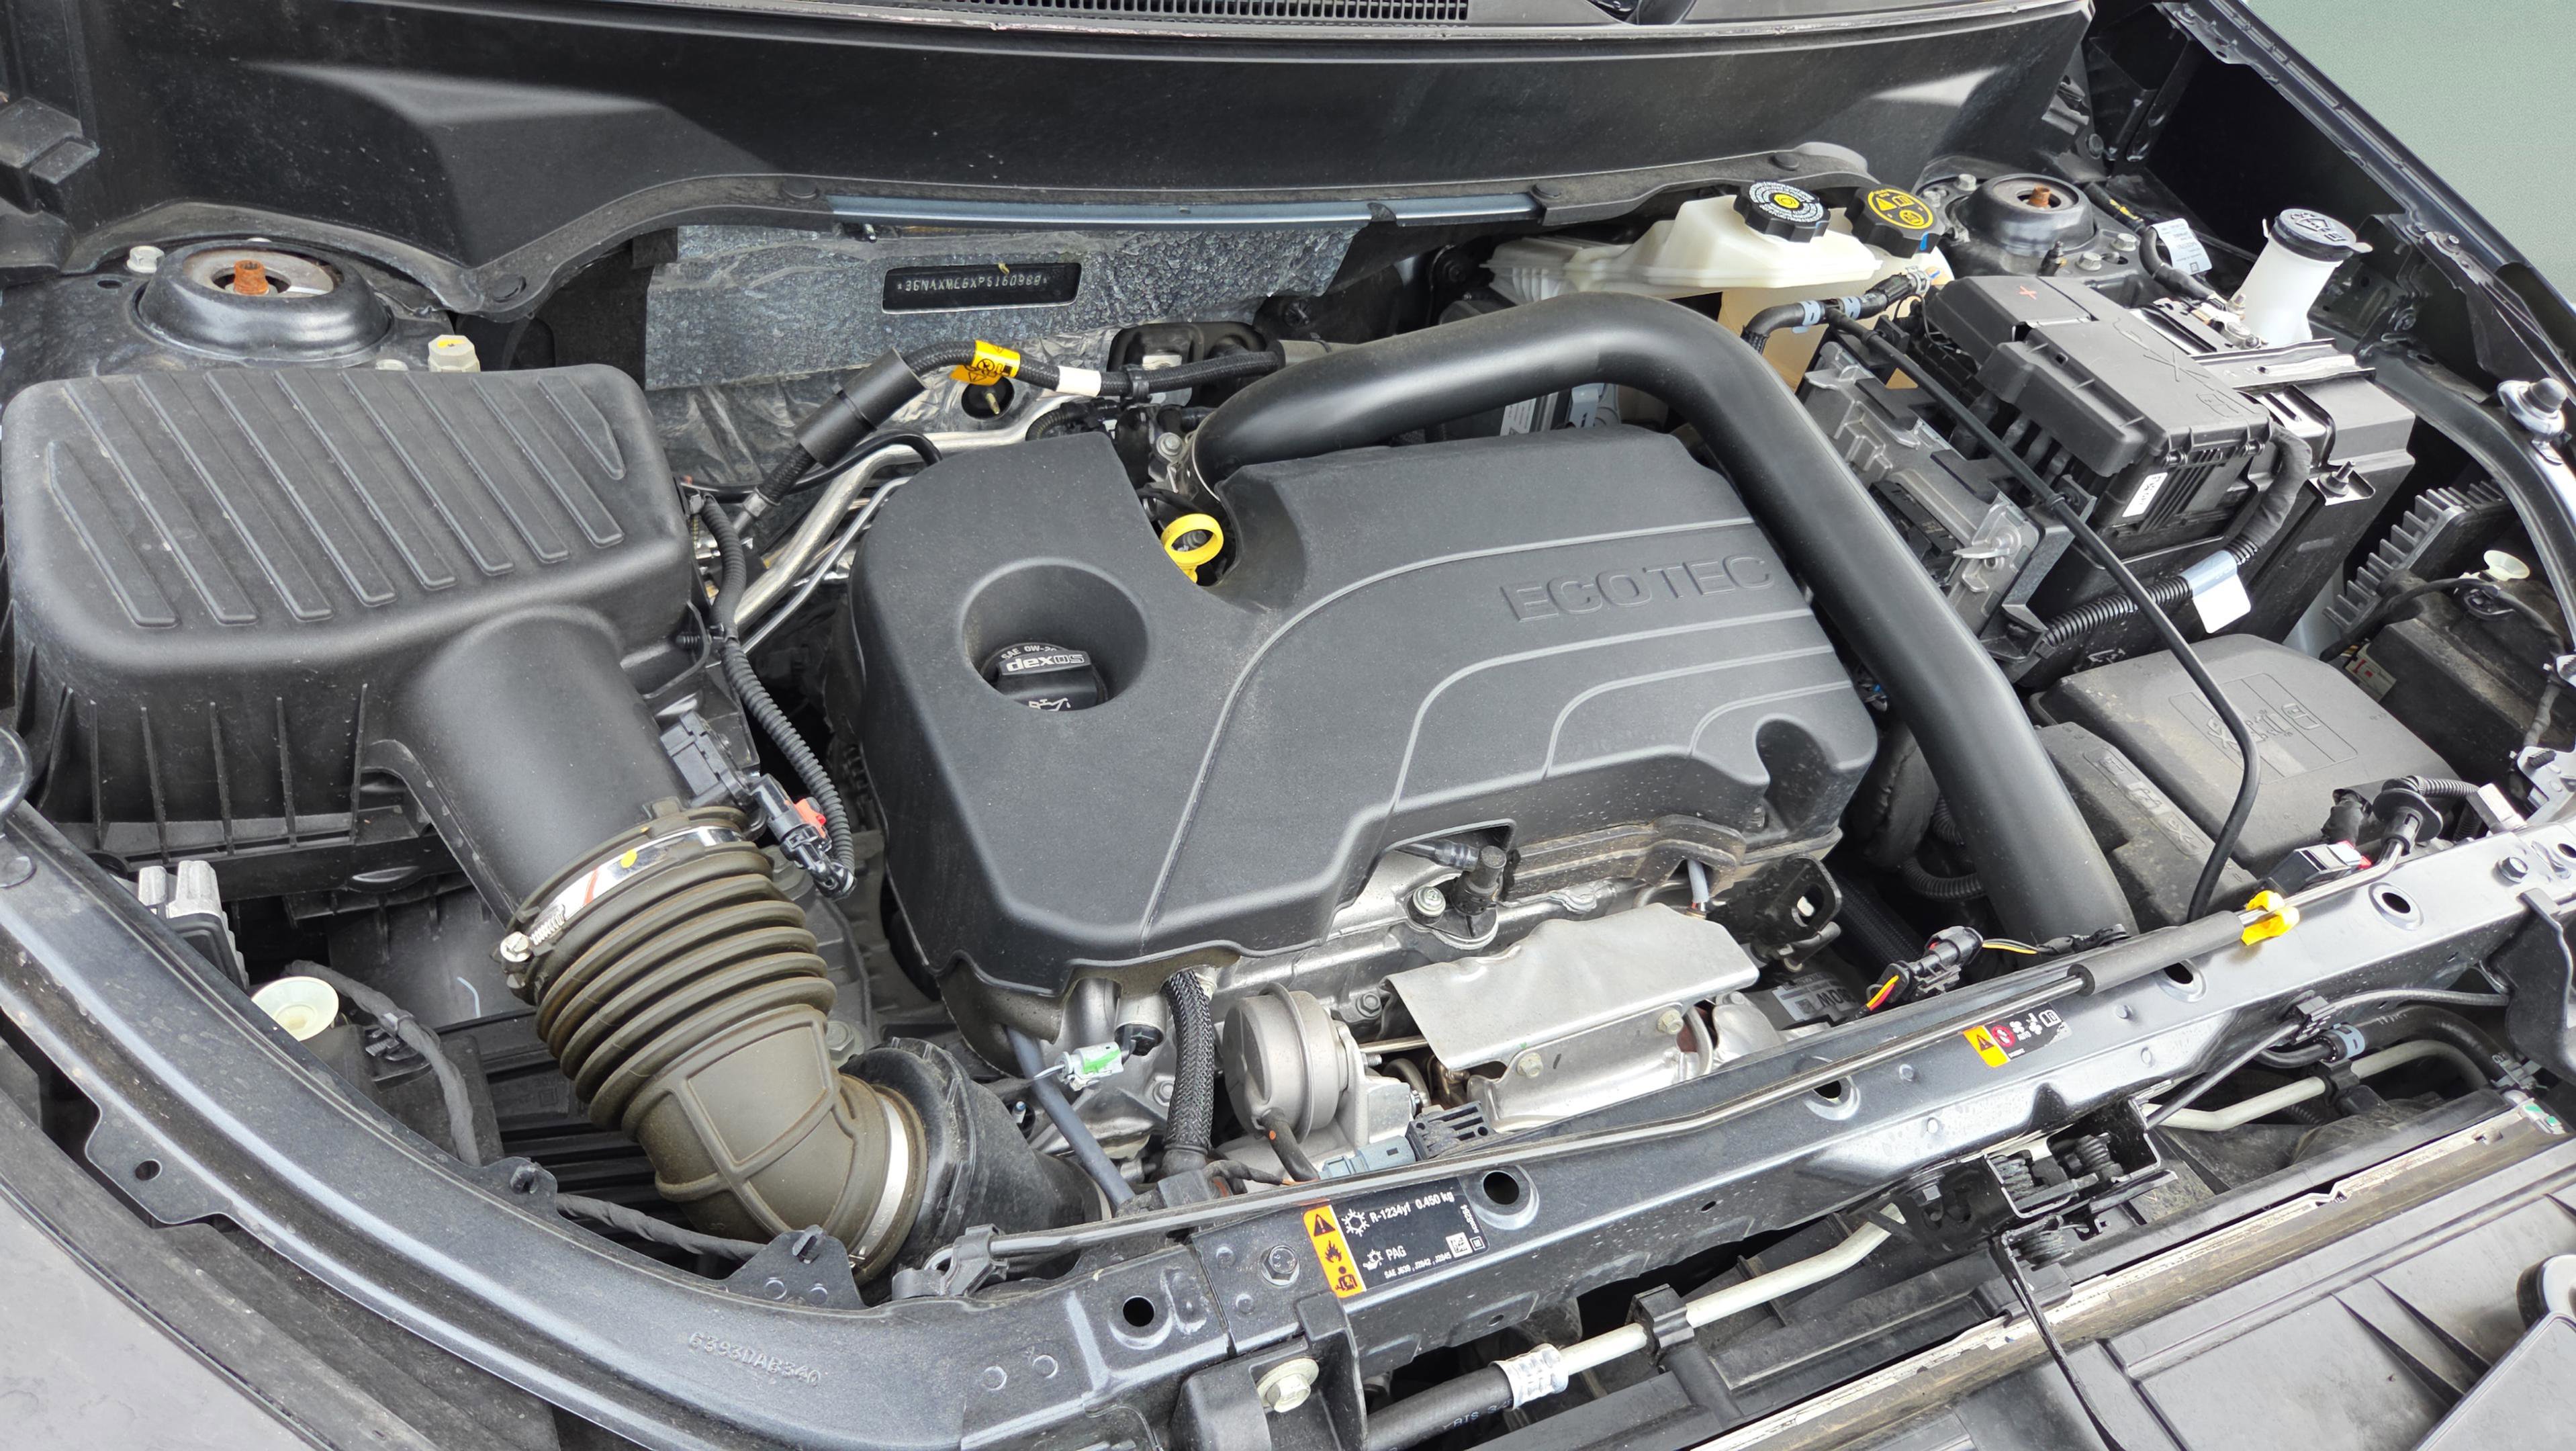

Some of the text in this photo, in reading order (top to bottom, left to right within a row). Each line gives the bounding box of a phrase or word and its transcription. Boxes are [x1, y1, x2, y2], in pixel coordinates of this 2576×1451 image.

[1500, 554, 1774, 622] ECOTEC
[1001, 648, 1021, 660] SAE
[1006, 654, 1085, 672] dexos
[1369, 1191, 1455, 1223] R-1234yf 0.450 kg
[1386, 1245, 1407, 1261] PAG
[1385, 1269, 1397, 1279] SAE
